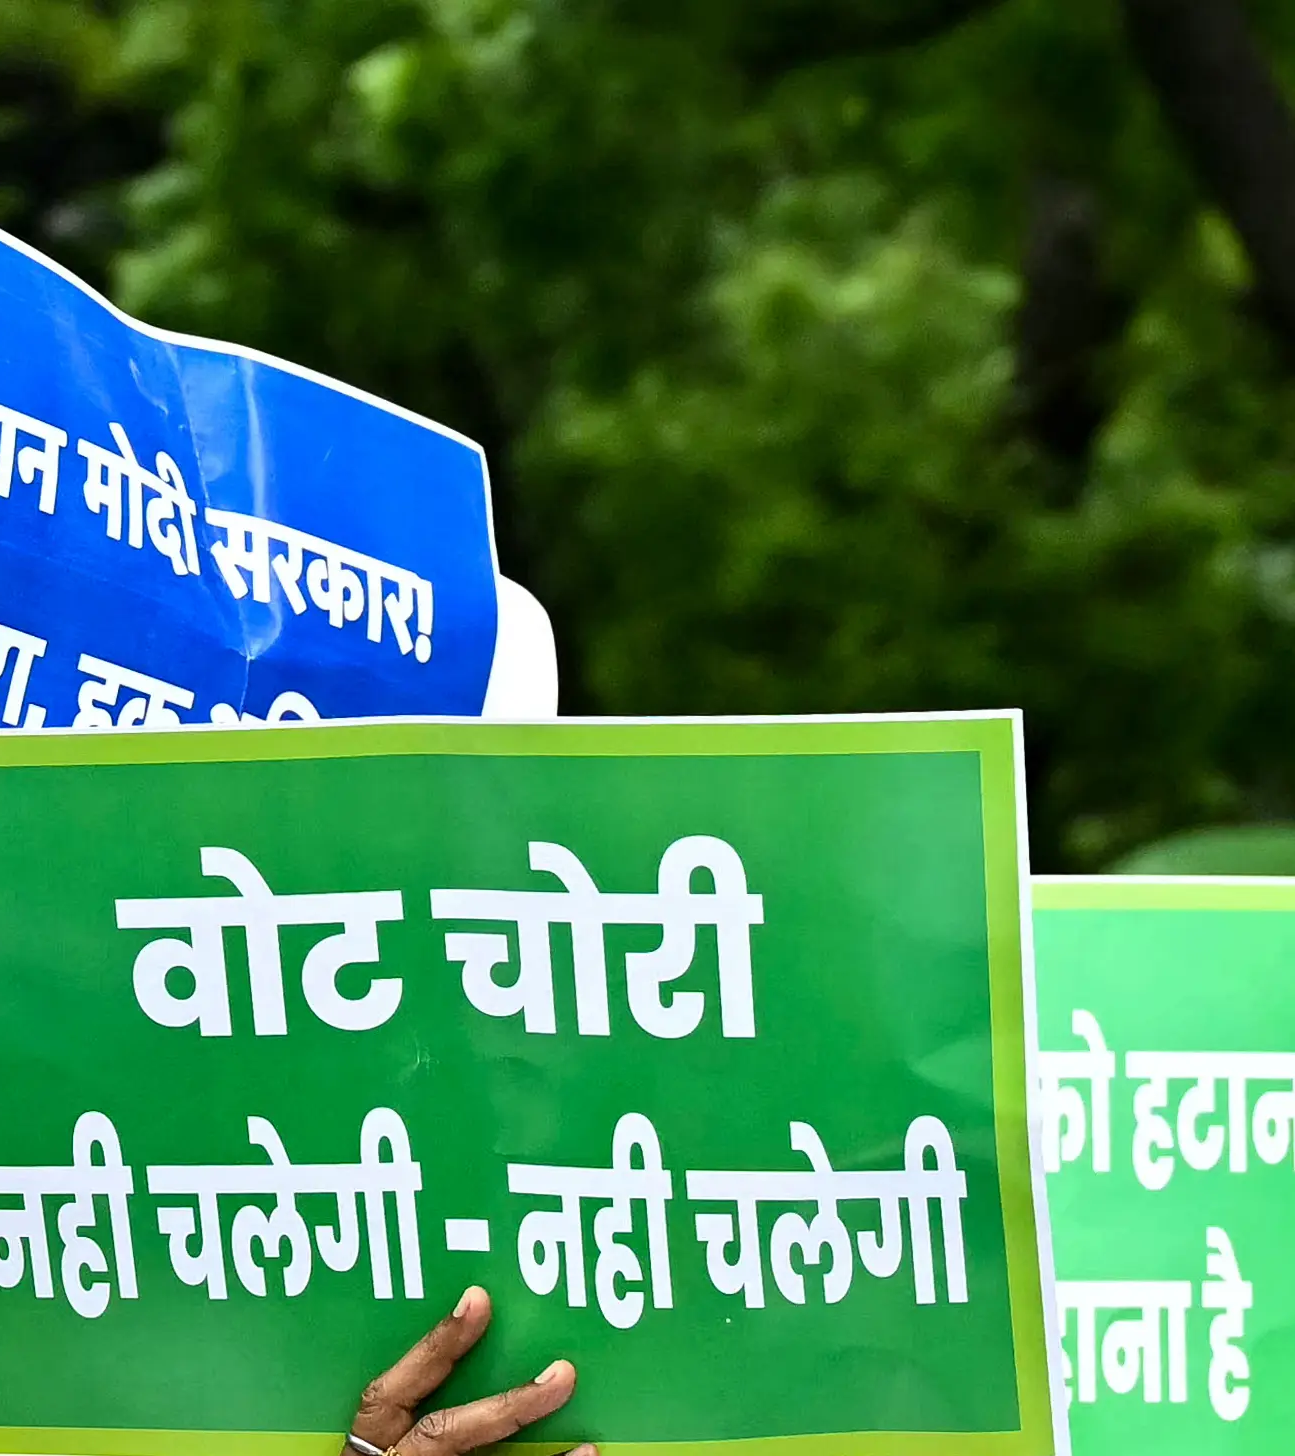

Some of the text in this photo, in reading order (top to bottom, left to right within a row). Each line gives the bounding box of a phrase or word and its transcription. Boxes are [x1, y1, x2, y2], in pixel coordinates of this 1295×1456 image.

[77, 423, 200, 576] मोदी
[204, 508, 433, 663] सरकार!
[114, 836, 765, 1039] वोट चोरी
[146, 1107, 424, 1300] चलेगी
[507, 1112, 674, 1329] नही
[686, 1115, 969, 1309] चलेगी
[1202, 1227, 1252, 1421] है
